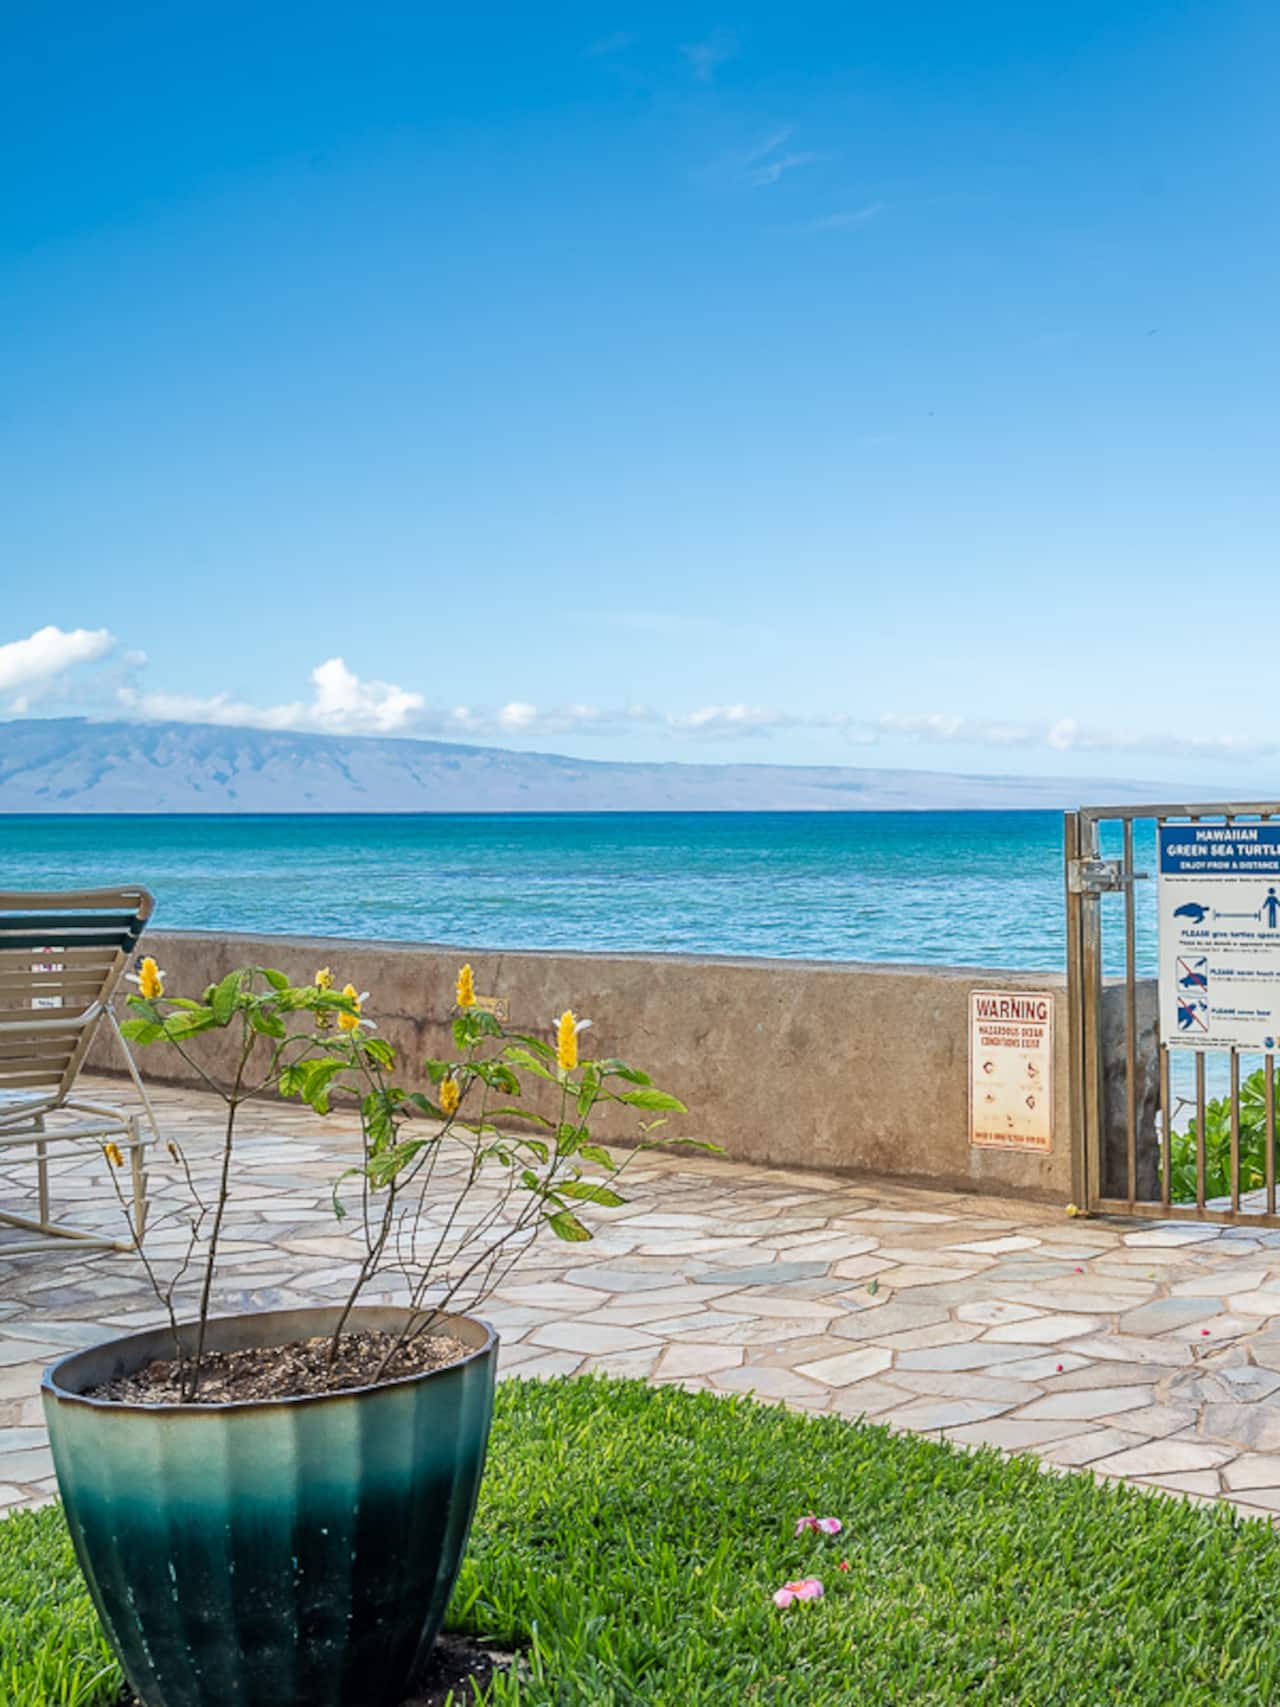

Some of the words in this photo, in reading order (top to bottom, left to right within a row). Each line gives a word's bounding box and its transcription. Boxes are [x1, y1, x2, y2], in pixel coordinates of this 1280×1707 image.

[1196, 829, 1258, 841] HAWAIIAN
[1167, 844, 1208, 856] GREEN
[1210, 844, 1234, 856] SEA
[1180, 861, 1205, 870] ENJOY
[1232, 861, 1239, 870] A
[976, 998, 1047, 1020] WARNING
